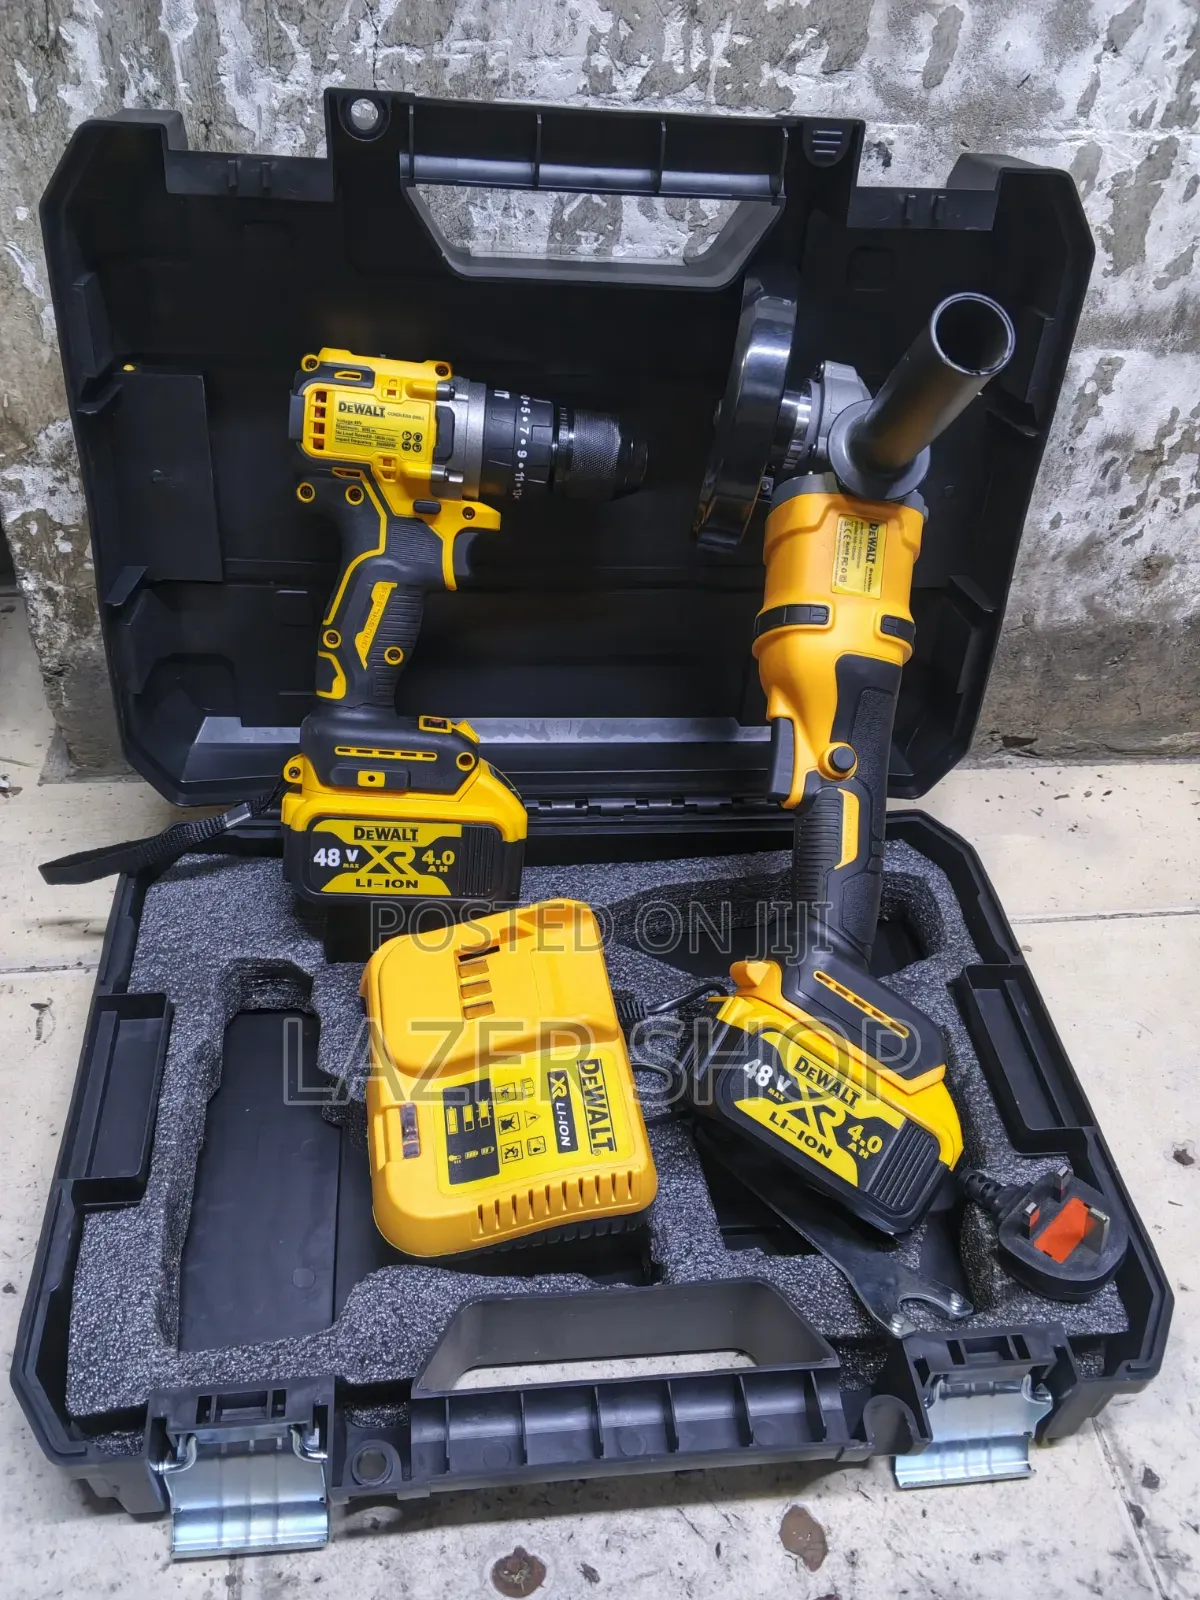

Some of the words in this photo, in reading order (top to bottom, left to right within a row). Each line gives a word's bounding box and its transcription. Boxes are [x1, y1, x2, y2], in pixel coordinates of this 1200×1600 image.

[339, 401, 385, 418] DEWALT
[521, 406, 531, 414] 5
[517, 450, 528, 458] 9
[514, 472, 525, 481] 11
[866, 523, 879, 564] DEWALT
[353, 825, 419, 843] DEWALT
[313, 847, 341, 867] 48
[345, 849, 360, 863] V
[421, 850, 456, 866] 4.0
[355, 878, 419, 889] LI-ION
[794, 1056, 861, 1109] DEWALT
[767, 1087, 785, 1102] MAX
[577, 1059, 615, 1152] DEWALT
[743, 1058, 774, 1087] 48
[776, 1074, 792, 1093] V
[847, 1124, 883, 1154] 4.0
[555, 1102, 571, 1147] LI-ION
[768, 1111, 833, 1159] LI-ION
